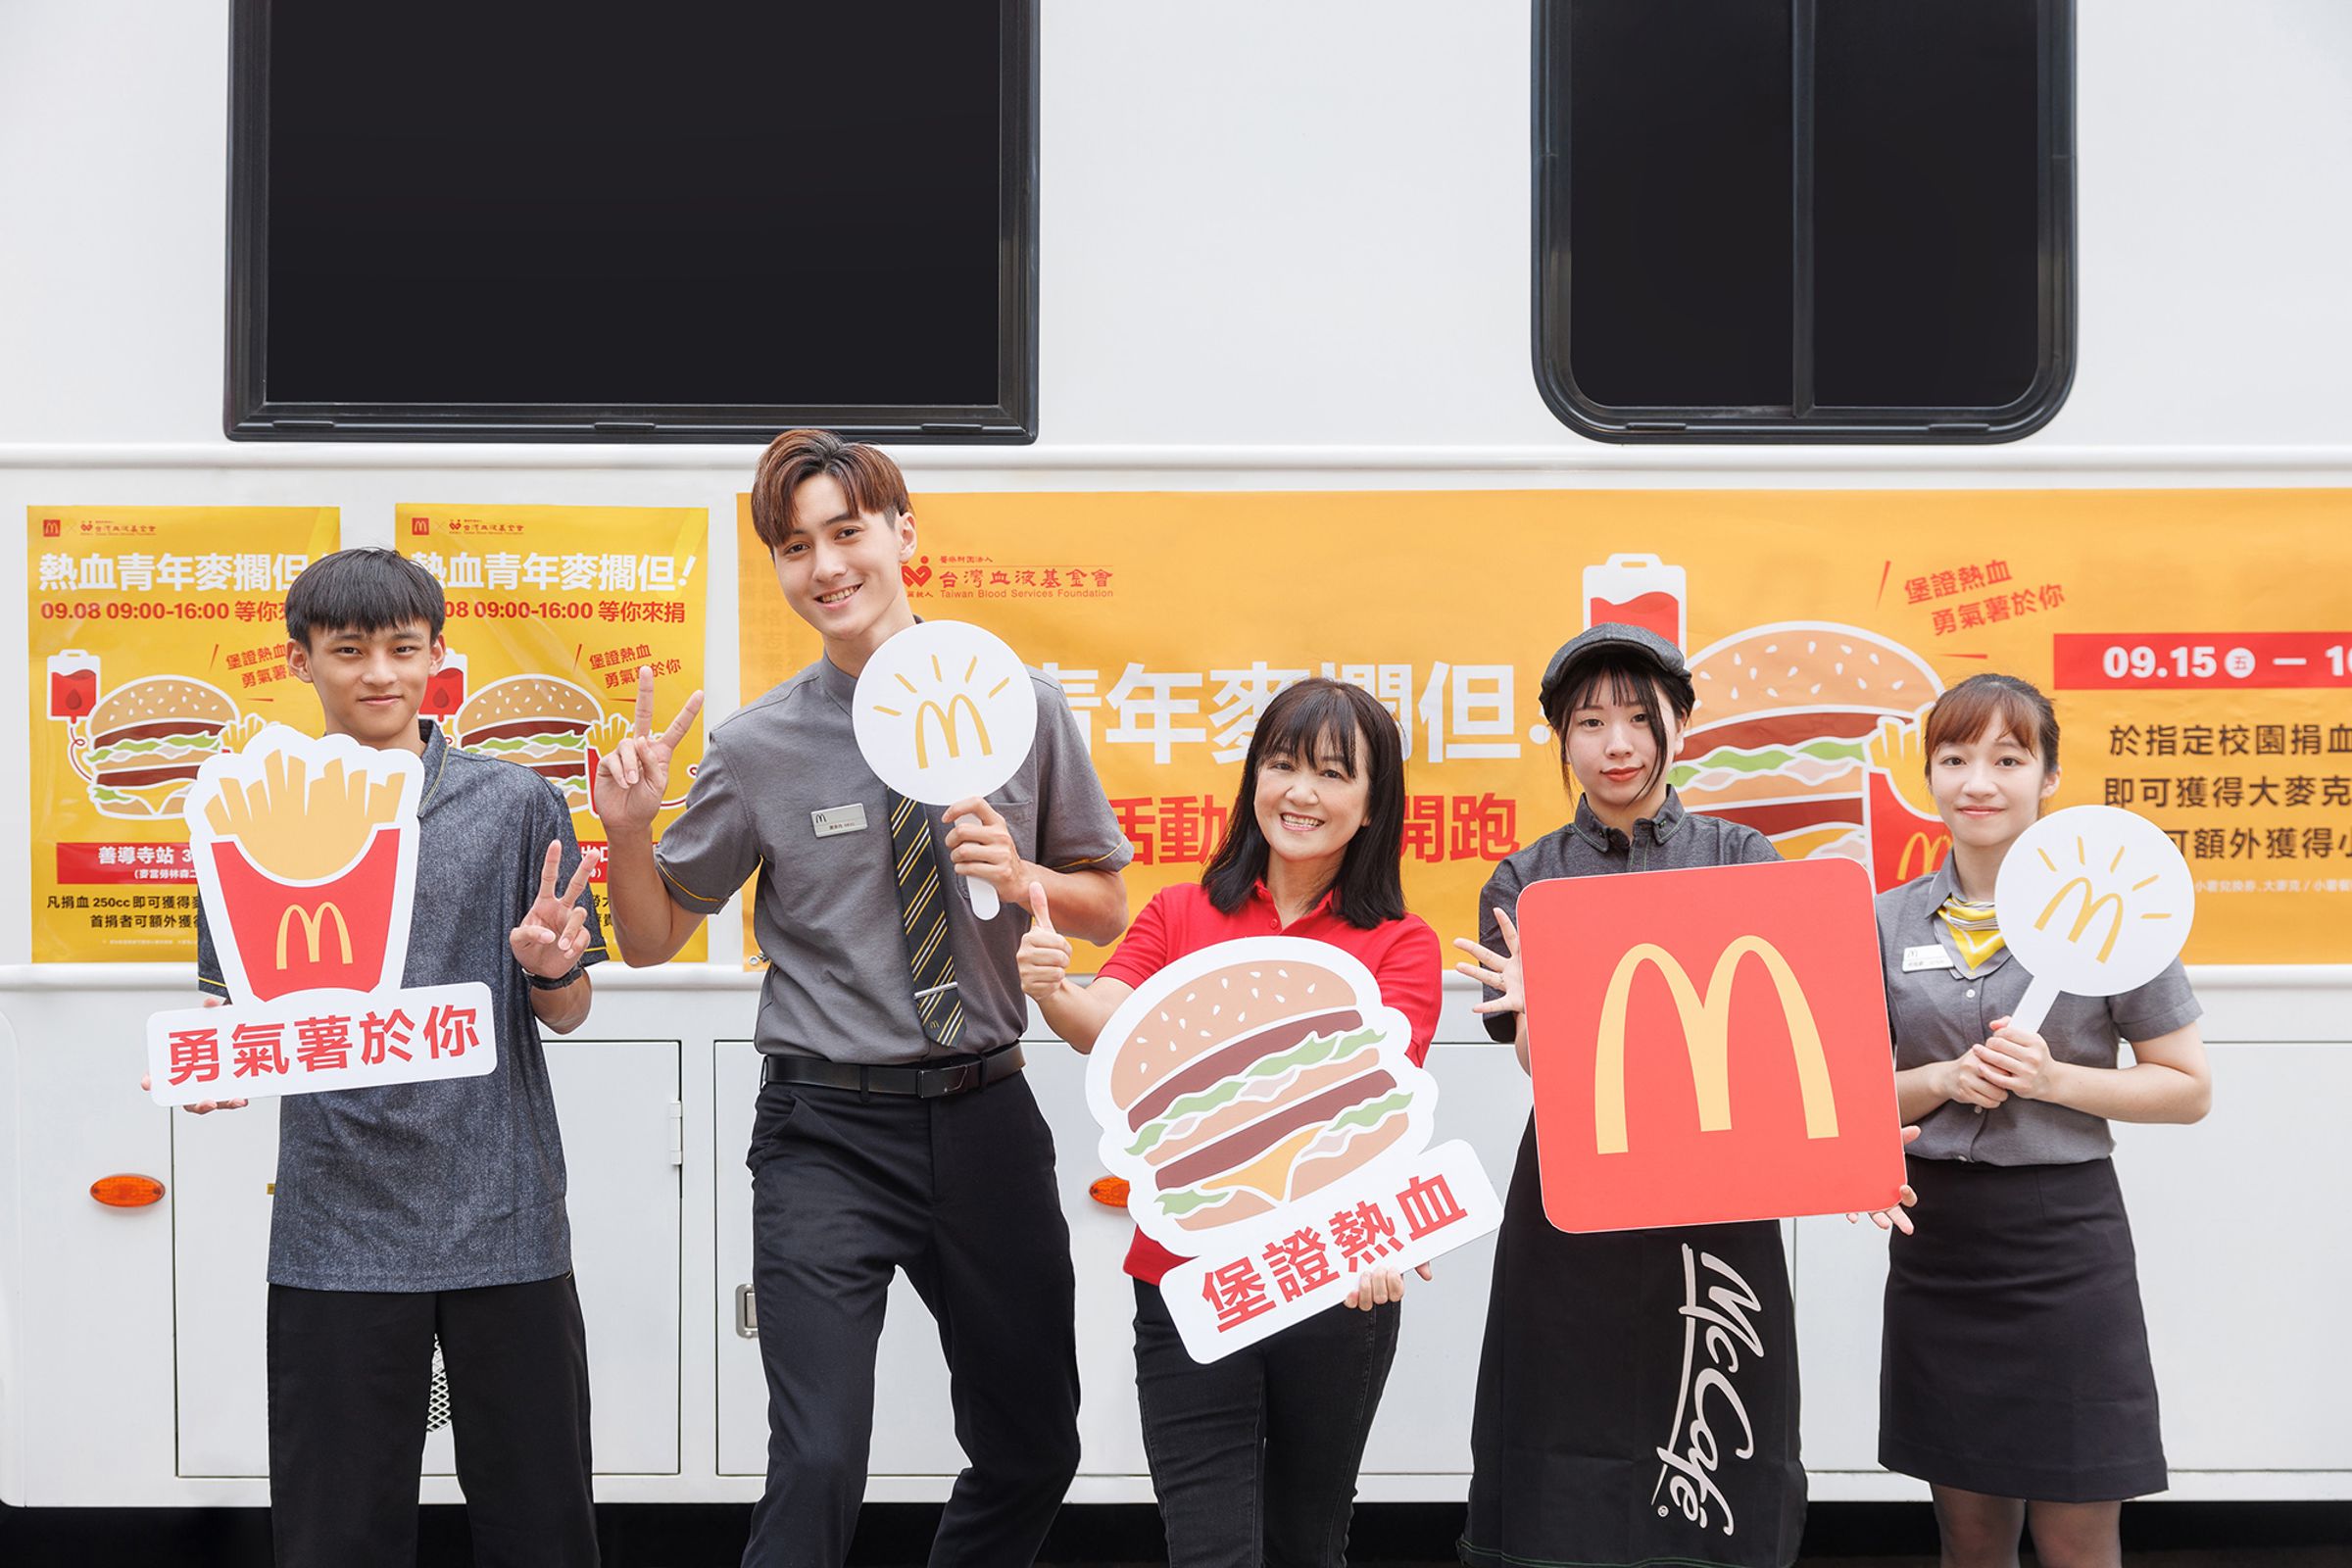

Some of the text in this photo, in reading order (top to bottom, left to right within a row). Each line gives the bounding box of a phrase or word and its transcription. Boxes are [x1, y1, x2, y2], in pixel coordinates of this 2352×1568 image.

[39, 551, 328, 592] 熱血青年麥擱但
[939, 567, 1113, 588] 台灣血液基金會
[1904, 560, 2012, 605] 堡證熱血
[940, 589, 973, 598] Taiwan
[978, 589, 1007, 598] Blood
[1011, 589, 1054, 598] Services
[1057, 588, 1113, 598] Foundation
[41, 602, 101, 619] 09.08
[107, 602, 229, 619] 09:00-16:00
[474, 601, 593, 618] 09:00-16:00
[599, 601, 685, 623] 等你來捐
[1932, 584, 2065, 636] 勇氣薯於你
[225, 643, 287, 670] 堡證熱血
[589, 644, 652, 670] 堡證熱血
[2103, 646, 2217, 678] 09.15
[2326, 645, 2352, 677] 1
[605, 659, 681, 689] 勇氣於你
[2110, 723, 2352, 757] 於指定校園捐血
[2105, 774, 2352, 808] 即可獲得大麥克
[99, 846, 174, 864] 善導寺站
[168, 1004, 479, 1086] 勇氣薯於你
[1201, 1174, 1467, 1334] 堡證熱血
